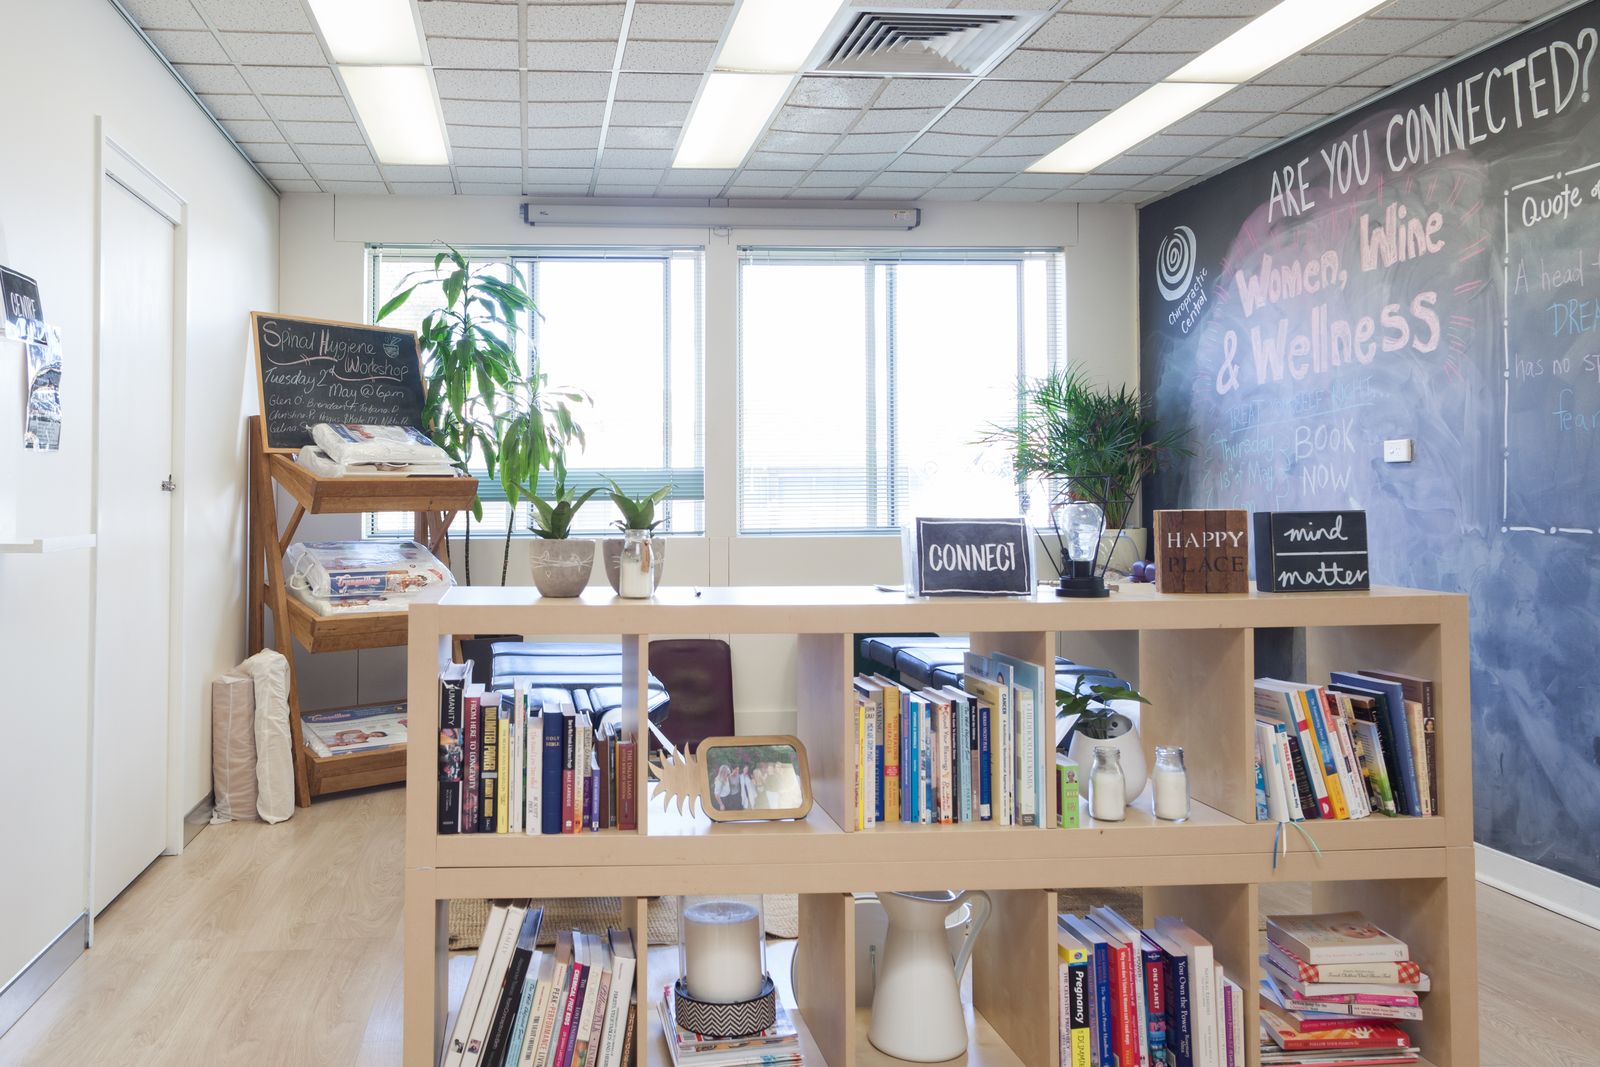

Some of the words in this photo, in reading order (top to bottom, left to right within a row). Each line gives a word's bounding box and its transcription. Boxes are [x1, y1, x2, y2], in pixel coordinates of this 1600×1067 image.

[1268, 157, 1315, 223] ARE
[1320, 130, 1370, 199] YOU
[1386, 28, 1598, 172] CONNECTED?
[1522, 184, 1582, 227] Quote
[1359, 202, 1446, 272] Wine
[1235, 250, 1348, 318] Women,
[1514, 258, 1528, 295] A
[1541, 249, 1584, 291] head
[1168, 267, 1208, 325] Chiropractic
[1181, 289, 1208, 334] Central
[263, 320, 316, 352] Spinal
[319, 329, 377, 361] Hygiene
[1215, 329, 1240, 395] &
[1250, 291, 1441, 385] Wellness
[264, 367, 317, 394] Tuesday
[344, 355, 408, 377] Workshop
[1515, 352, 1544, 382] has
[1553, 358, 1570, 375] no
[269, 394, 291, 406] Glen
[329, 383, 358, 402] May
[360, 383, 374, 398] @
[376, 385, 405, 402] 6pm
[1216, 435, 1274, 462] Thursday
[1295, 418, 1356, 464] BOOK
[1248, 461, 1273, 492] May
[1302, 462, 1352, 497] NOW
[1167, 531, 1244, 548] HAPPY
[1283, 515, 1348, 542] mind
[927, 540, 1016, 573] CONNECT
[1168, 556, 1245, 572] PLACE
[1278, 561, 1368, 588] matter
[483, 708, 496, 744] UNLIMITED
[469, 740, 476, 750] TO
[483, 745, 496, 771] POWER
[569, 969, 580, 997] CHEMICAL
[1074, 971, 1085, 1023] Pregnancy
[1178, 977, 1186, 996] Own
[564, 1012, 572, 1026] KIDS
[566, 998, 576, 1011] FREE
[592, 1015, 602, 1033] TALK
